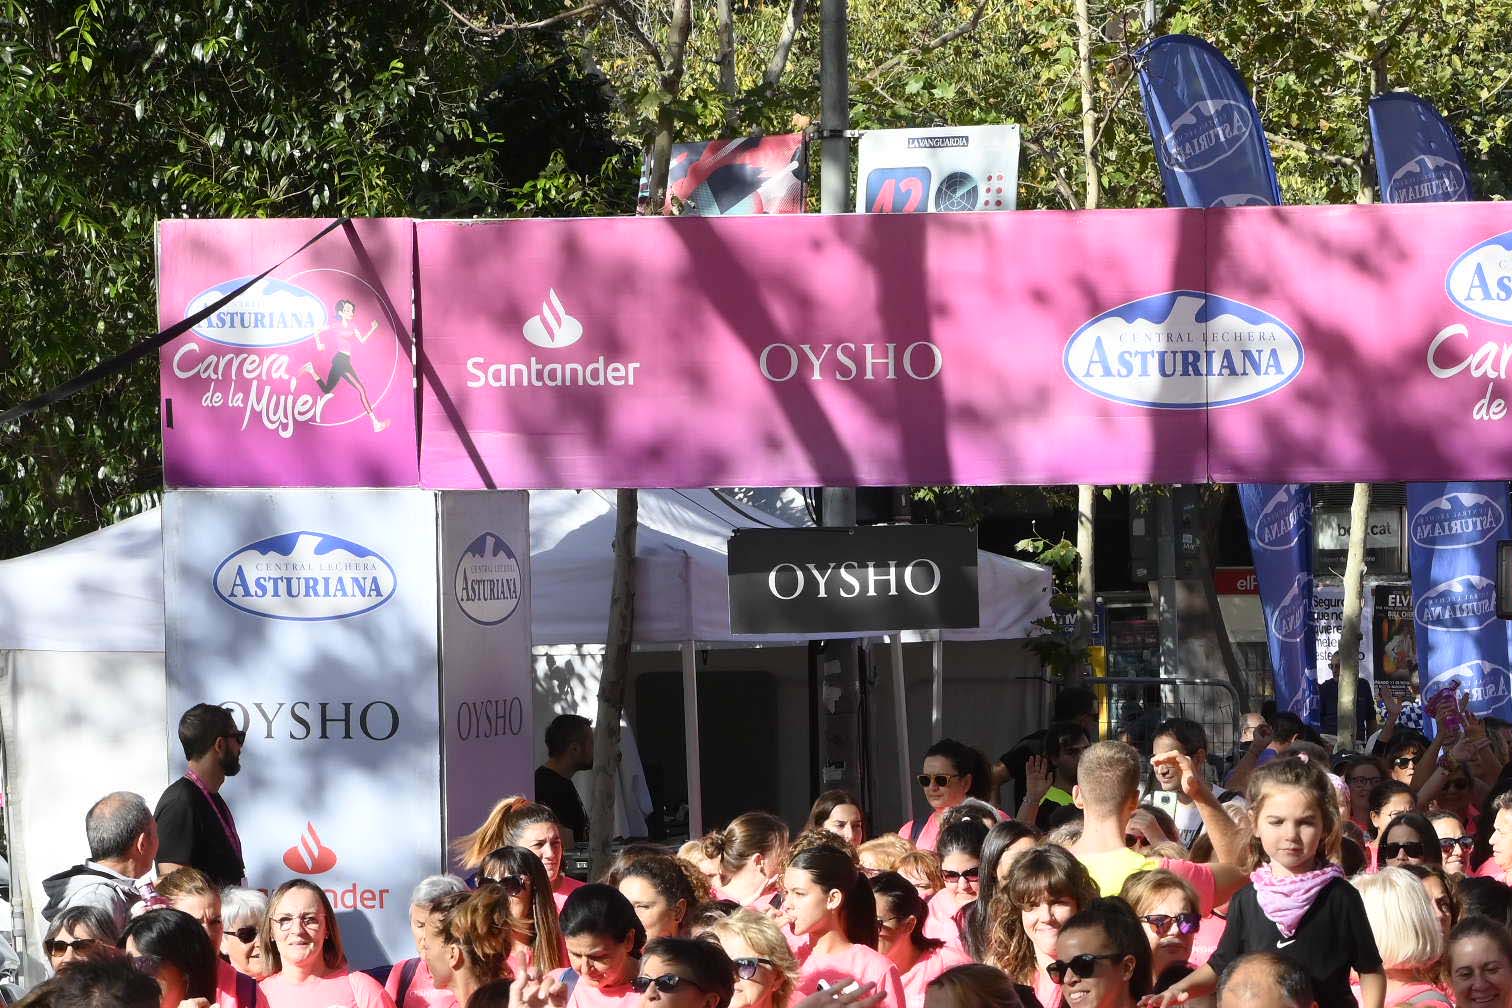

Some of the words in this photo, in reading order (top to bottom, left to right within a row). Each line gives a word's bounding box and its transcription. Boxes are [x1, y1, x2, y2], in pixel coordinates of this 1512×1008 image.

[172, 342, 290, 379] Carrera
[466, 357, 640, 388] Santander
[759, 341, 943, 382] OYSHO
[1082, 335, 1285, 377] ASTURIANA
[201, 381, 223, 407] de
[228, 382, 244, 407] la
[241, 376, 335, 438] Mujer
[1472, 382, 1507, 421] de
[228, 564, 383, 598] ASTURIANA
[460, 565, 517, 602] ASTURIANA
[768, 558, 941, 600] OYSHO
[457, 697, 523, 741] OYSHO
